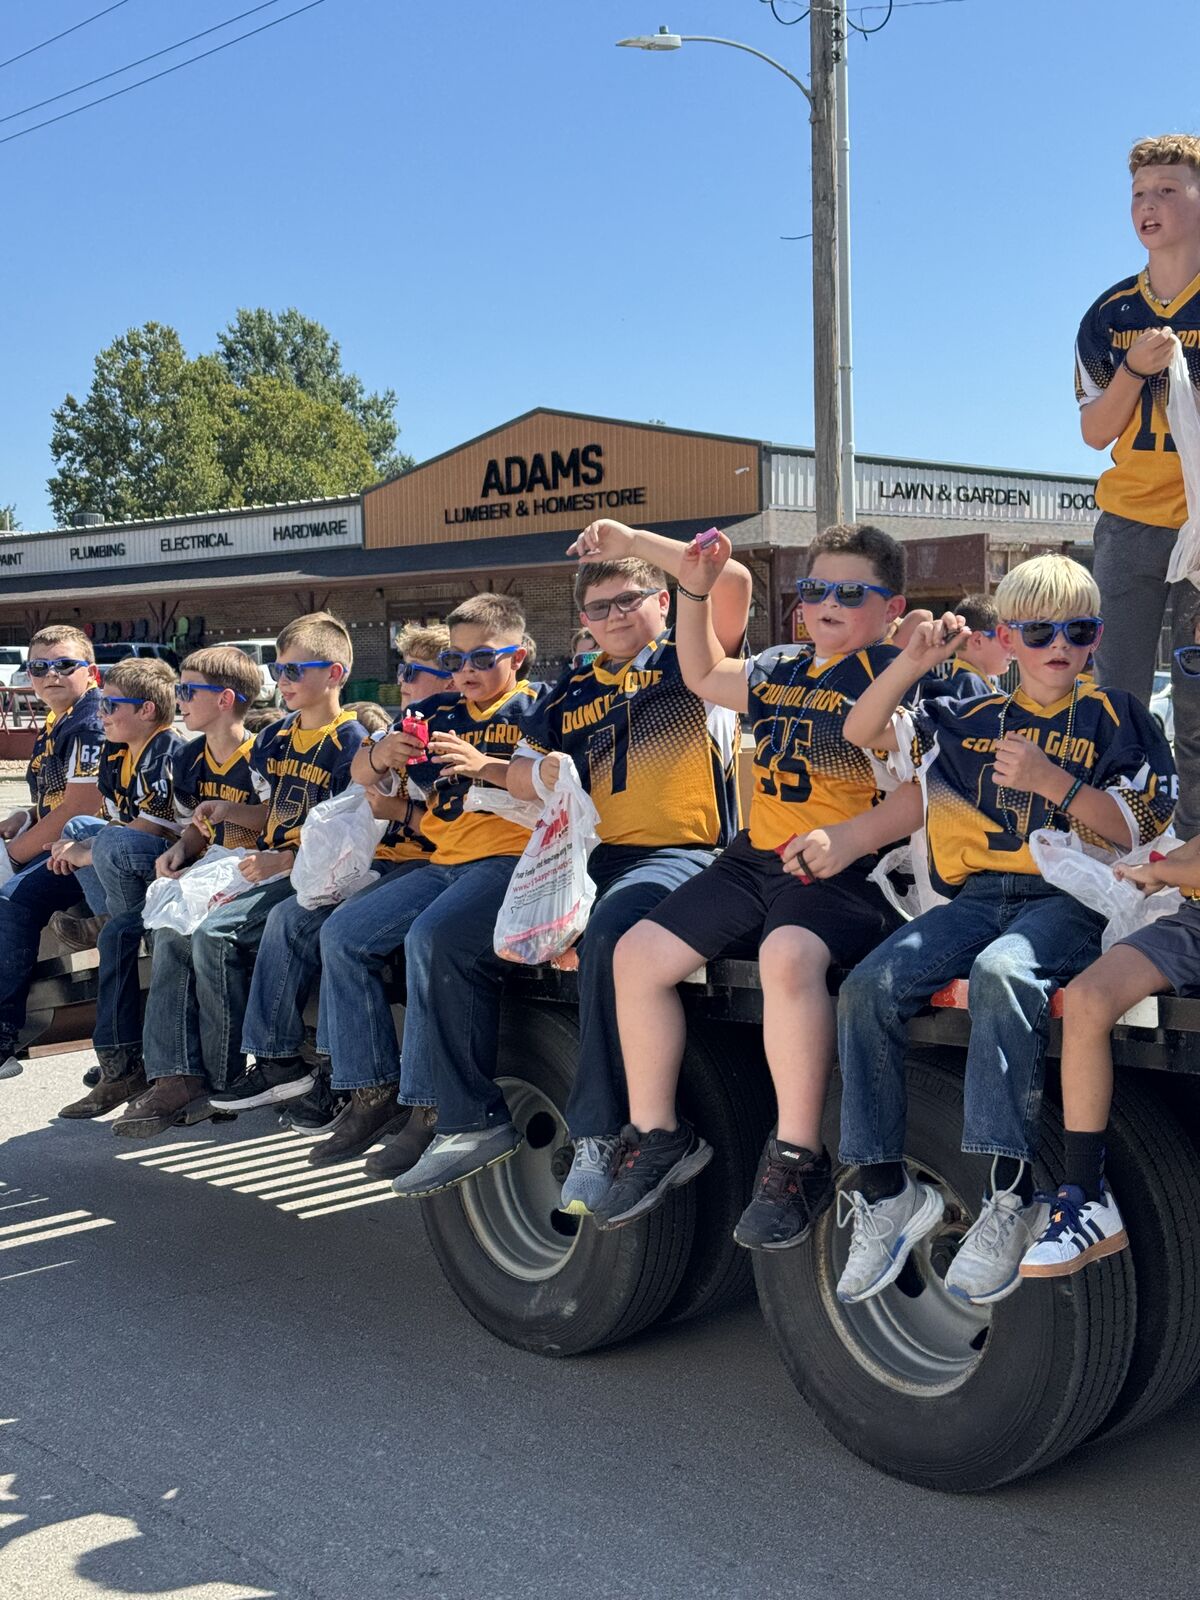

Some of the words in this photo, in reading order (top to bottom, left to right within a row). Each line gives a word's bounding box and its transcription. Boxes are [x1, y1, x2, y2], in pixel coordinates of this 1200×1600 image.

[481, 444, 604, 498] ADAMS
[880, 481, 934, 501] LAWN
[937, 484, 952, 502] &
[956, 485, 1031, 506] GARDEN
[1060, 492, 1100, 511] DOO
[444, 502, 510, 524] LUMBER
[516, 500, 529, 517] &
[533, 487, 646, 516] HOMESTORE
[272, 519, 348, 541] HARDWARE
[69, 542, 126, 561] PLUMBING
[160, 532, 234, 552] ELECTRICAL
[0, 552, 24, 567] AINT
[562, 690, 616, 734] OUNCI
[484, 723, 522, 744] GRO
[80, 744, 101, 764] 62
[753, 716, 814, 804] 25
[151, 778, 169, 799] 79
